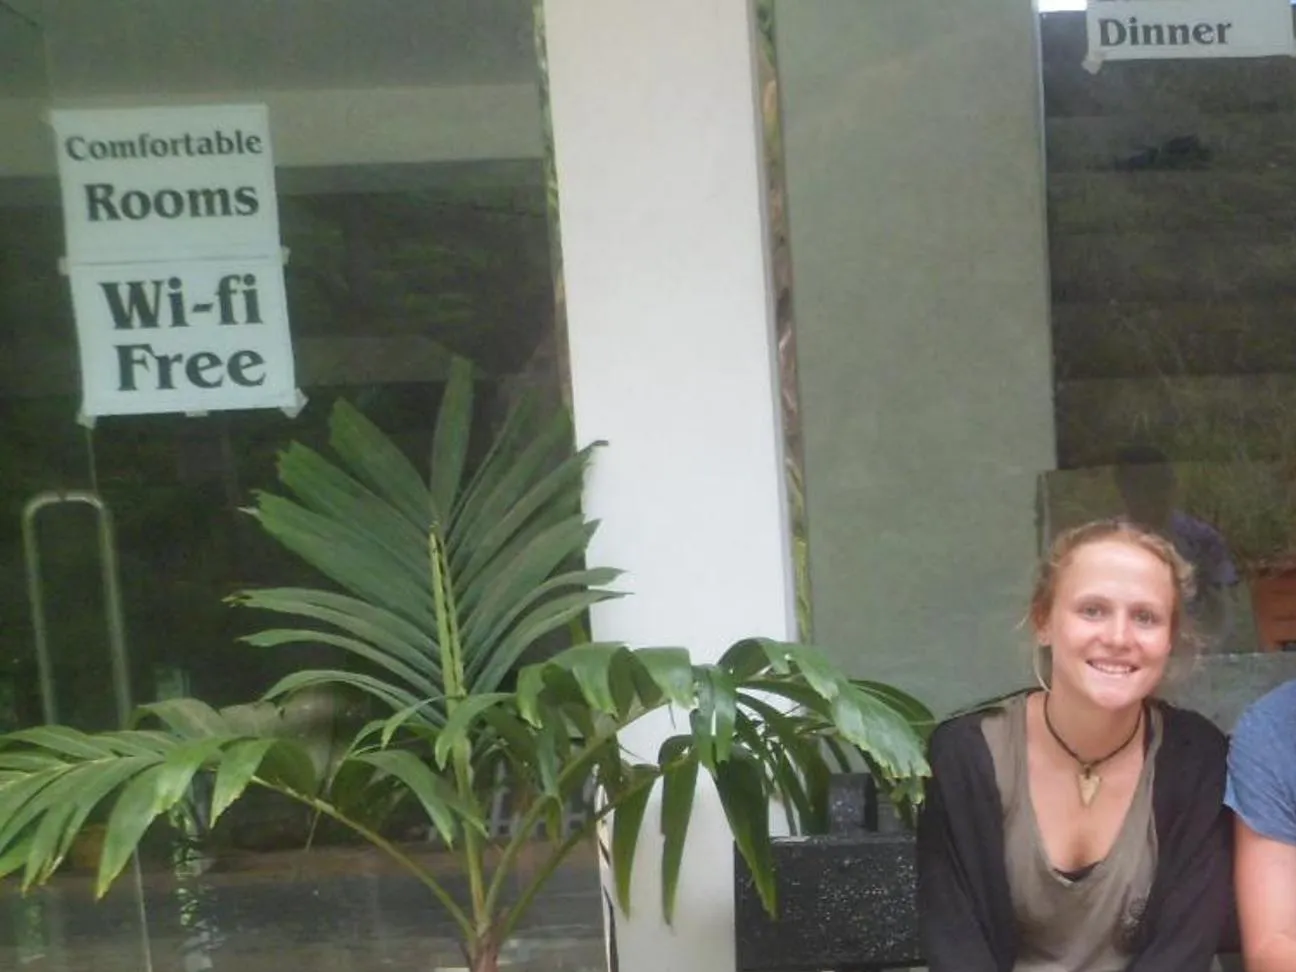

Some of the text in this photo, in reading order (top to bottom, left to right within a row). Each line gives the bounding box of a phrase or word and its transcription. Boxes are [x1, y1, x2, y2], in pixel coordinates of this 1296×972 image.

[1098, 16, 1232, 46] Dinner
[65, 130, 263, 161] Comfortable
[83, 182, 260, 222] Rooms
[98, 273, 264, 330] Wi-fi
[113, 342, 267, 391] Free
